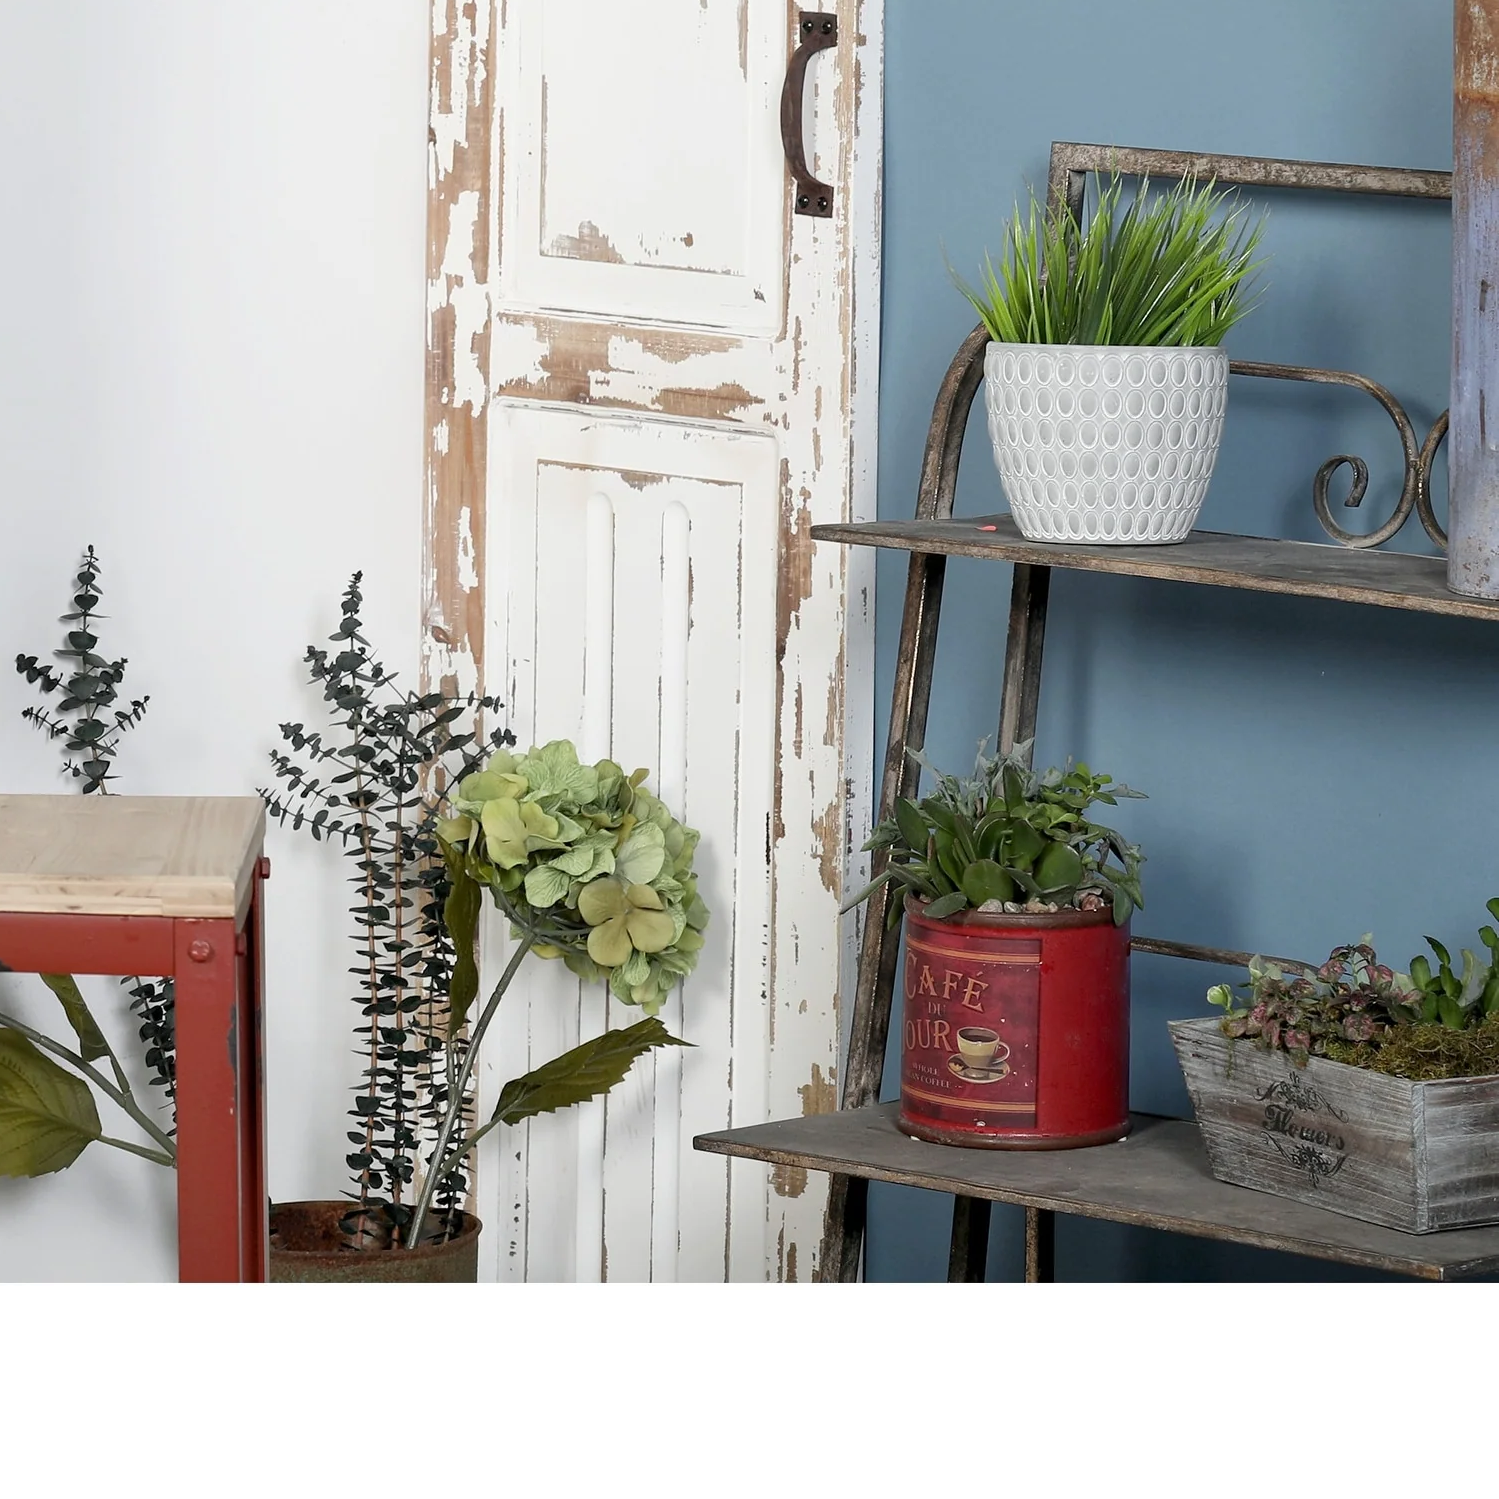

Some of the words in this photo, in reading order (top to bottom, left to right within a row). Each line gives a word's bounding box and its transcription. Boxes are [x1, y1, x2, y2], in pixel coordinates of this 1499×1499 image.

[905, 948, 989, 1013] CAFÉ
[928, 1002, 946, 1016] DU
[904, 1019, 954, 1052] OUR
[1263, 1104, 1345, 1150] Flowers
